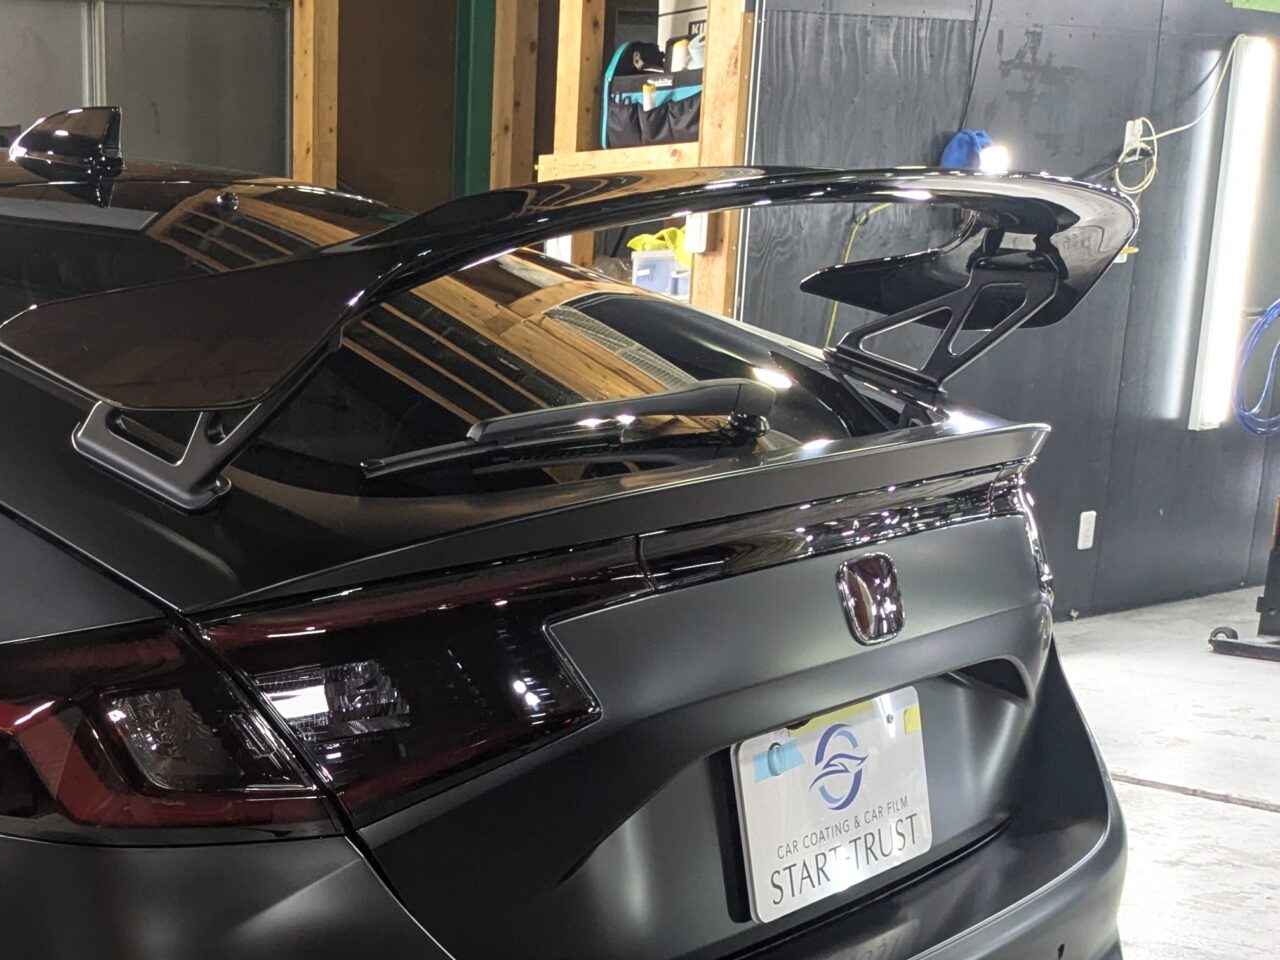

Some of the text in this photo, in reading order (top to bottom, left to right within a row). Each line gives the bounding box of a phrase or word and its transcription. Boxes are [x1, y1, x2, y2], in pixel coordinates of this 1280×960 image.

[777, 796, 909, 859] CAR COATING & CAR FILM
